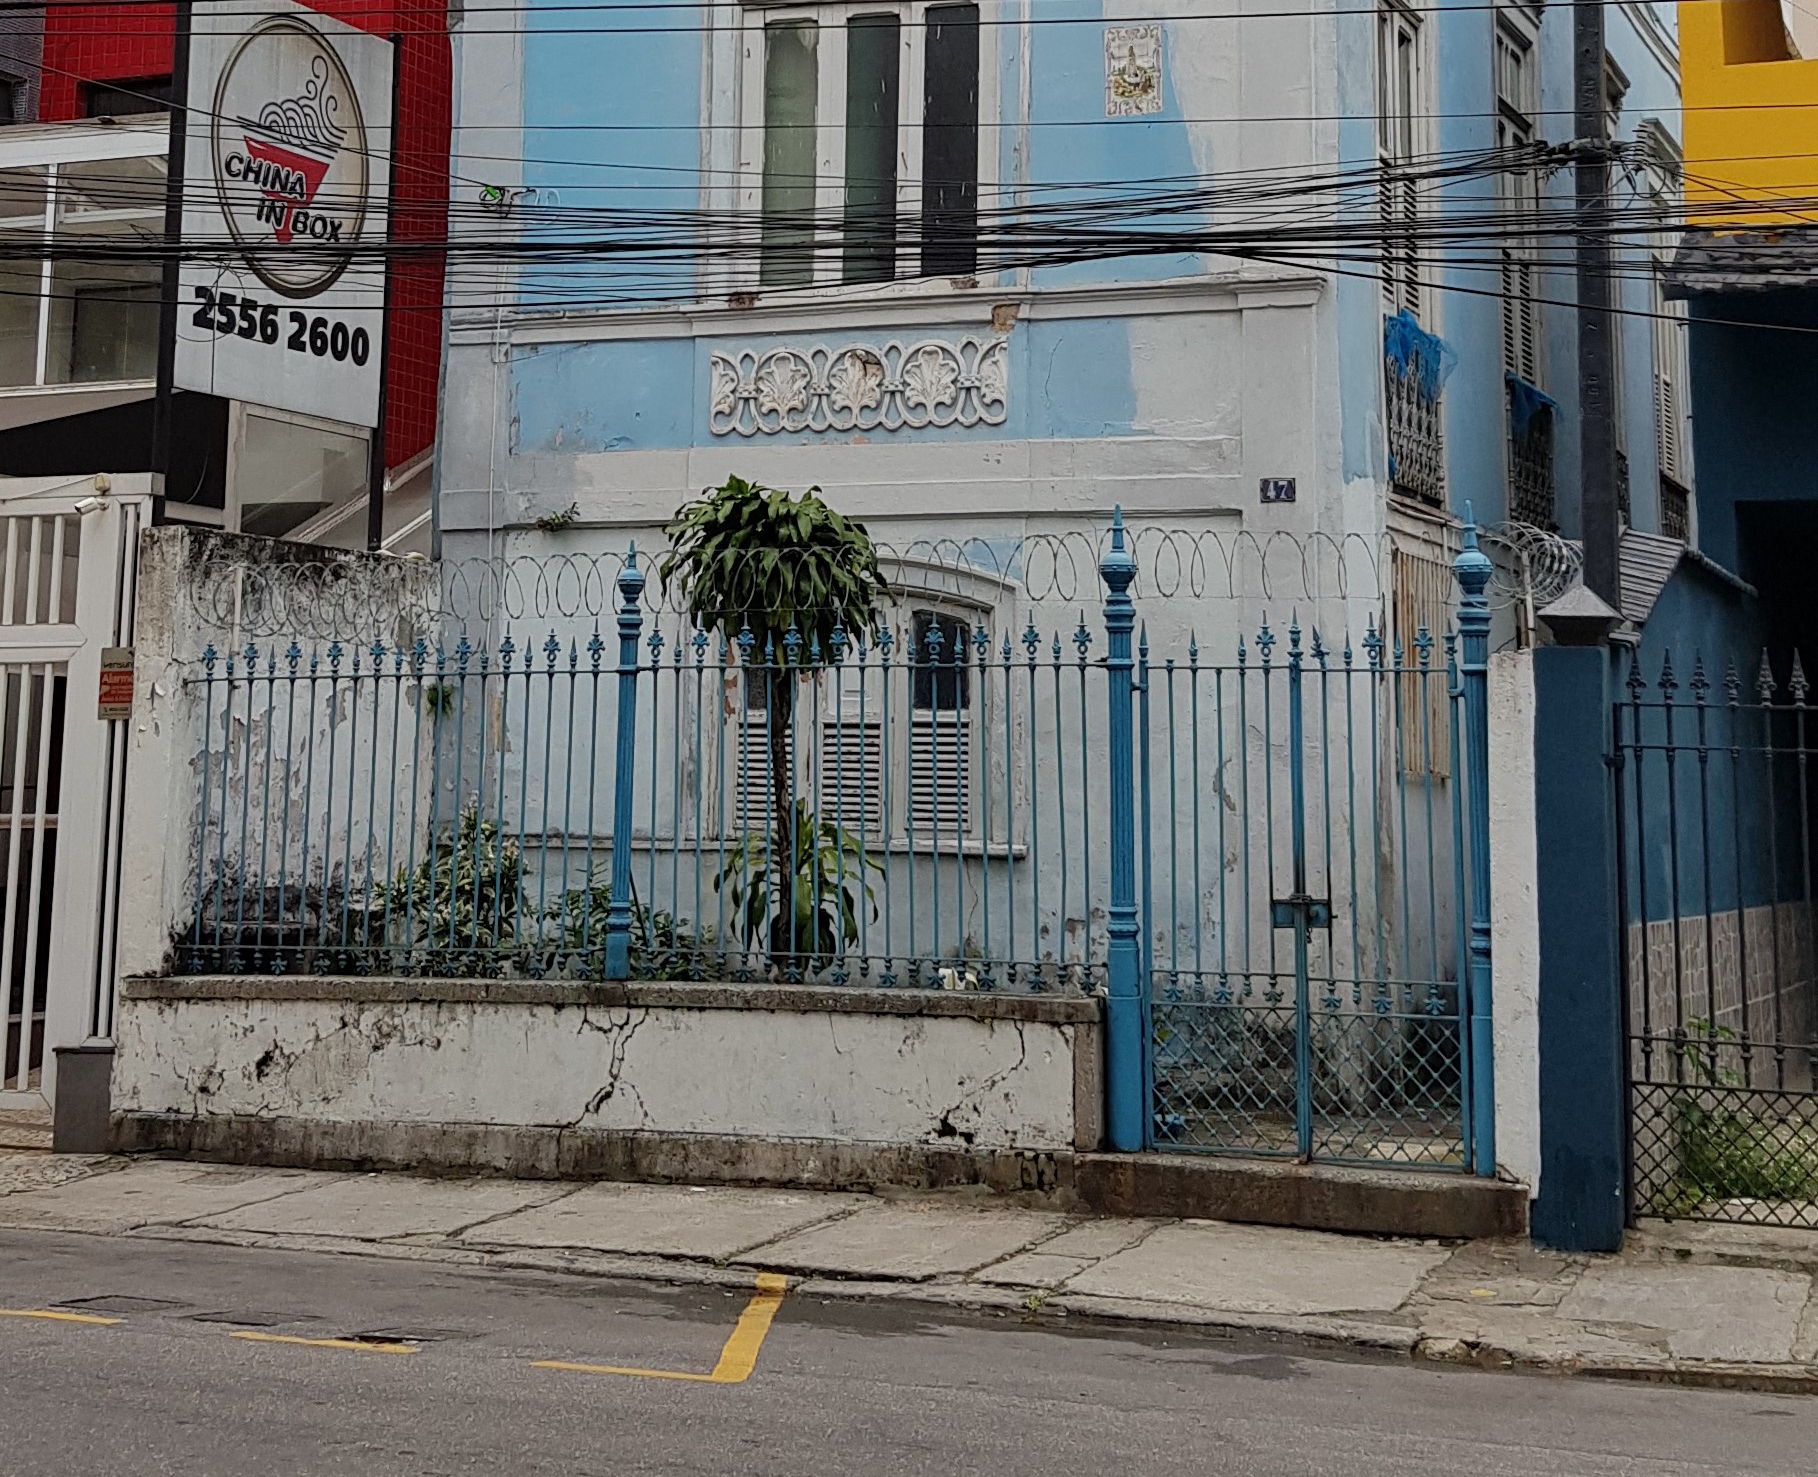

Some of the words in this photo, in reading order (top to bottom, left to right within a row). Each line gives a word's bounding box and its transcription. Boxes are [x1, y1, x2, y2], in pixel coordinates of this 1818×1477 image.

[224, 153, 306, 200] CHINA
[256, 197, 286, 227] IN
[291, 210, 343, 242] BOX
[192, 286, 279, 345] 2556
[287, 310, 370, 366] 2600
[1266, 480, 1288, 499] 47
